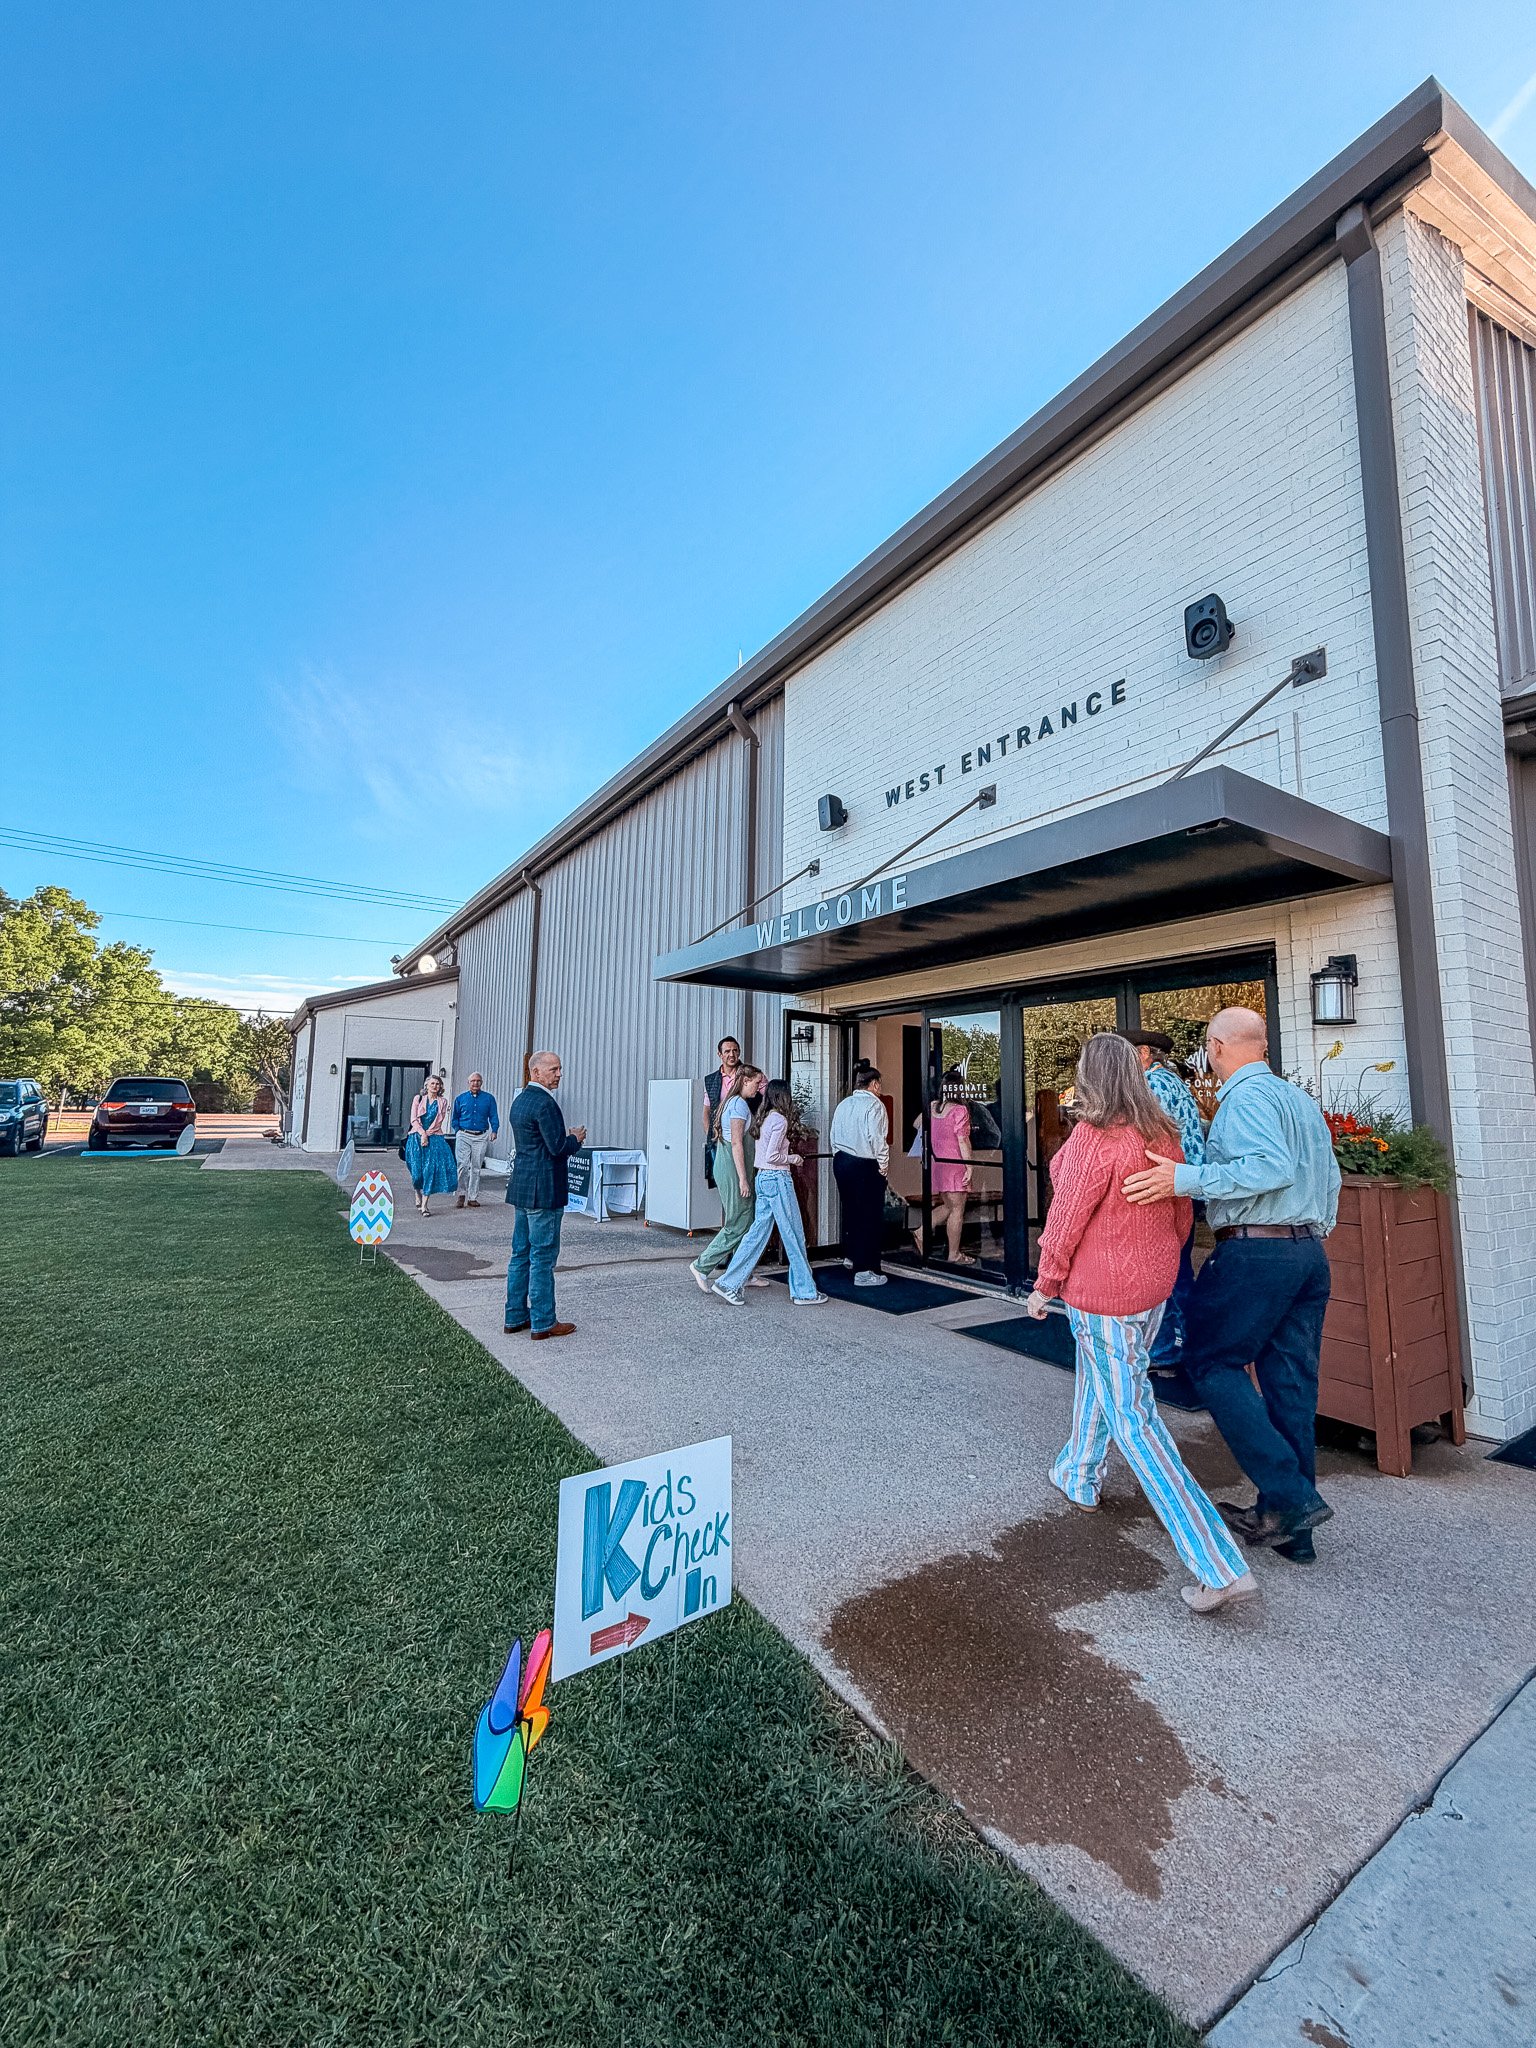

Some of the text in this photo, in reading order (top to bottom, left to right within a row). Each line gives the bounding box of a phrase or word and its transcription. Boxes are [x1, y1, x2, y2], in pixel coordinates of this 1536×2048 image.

[885, 678, 1127, 808] WEST ENTRANCE
[756, 876, 907, 949] WELCOME
[942, 1083, 987, 1092] RESONATE
[582, 1469, 696, 1621] Kids
[640, 1512, 730, 1601] Check
[684, 1567, 717, 1618] In
